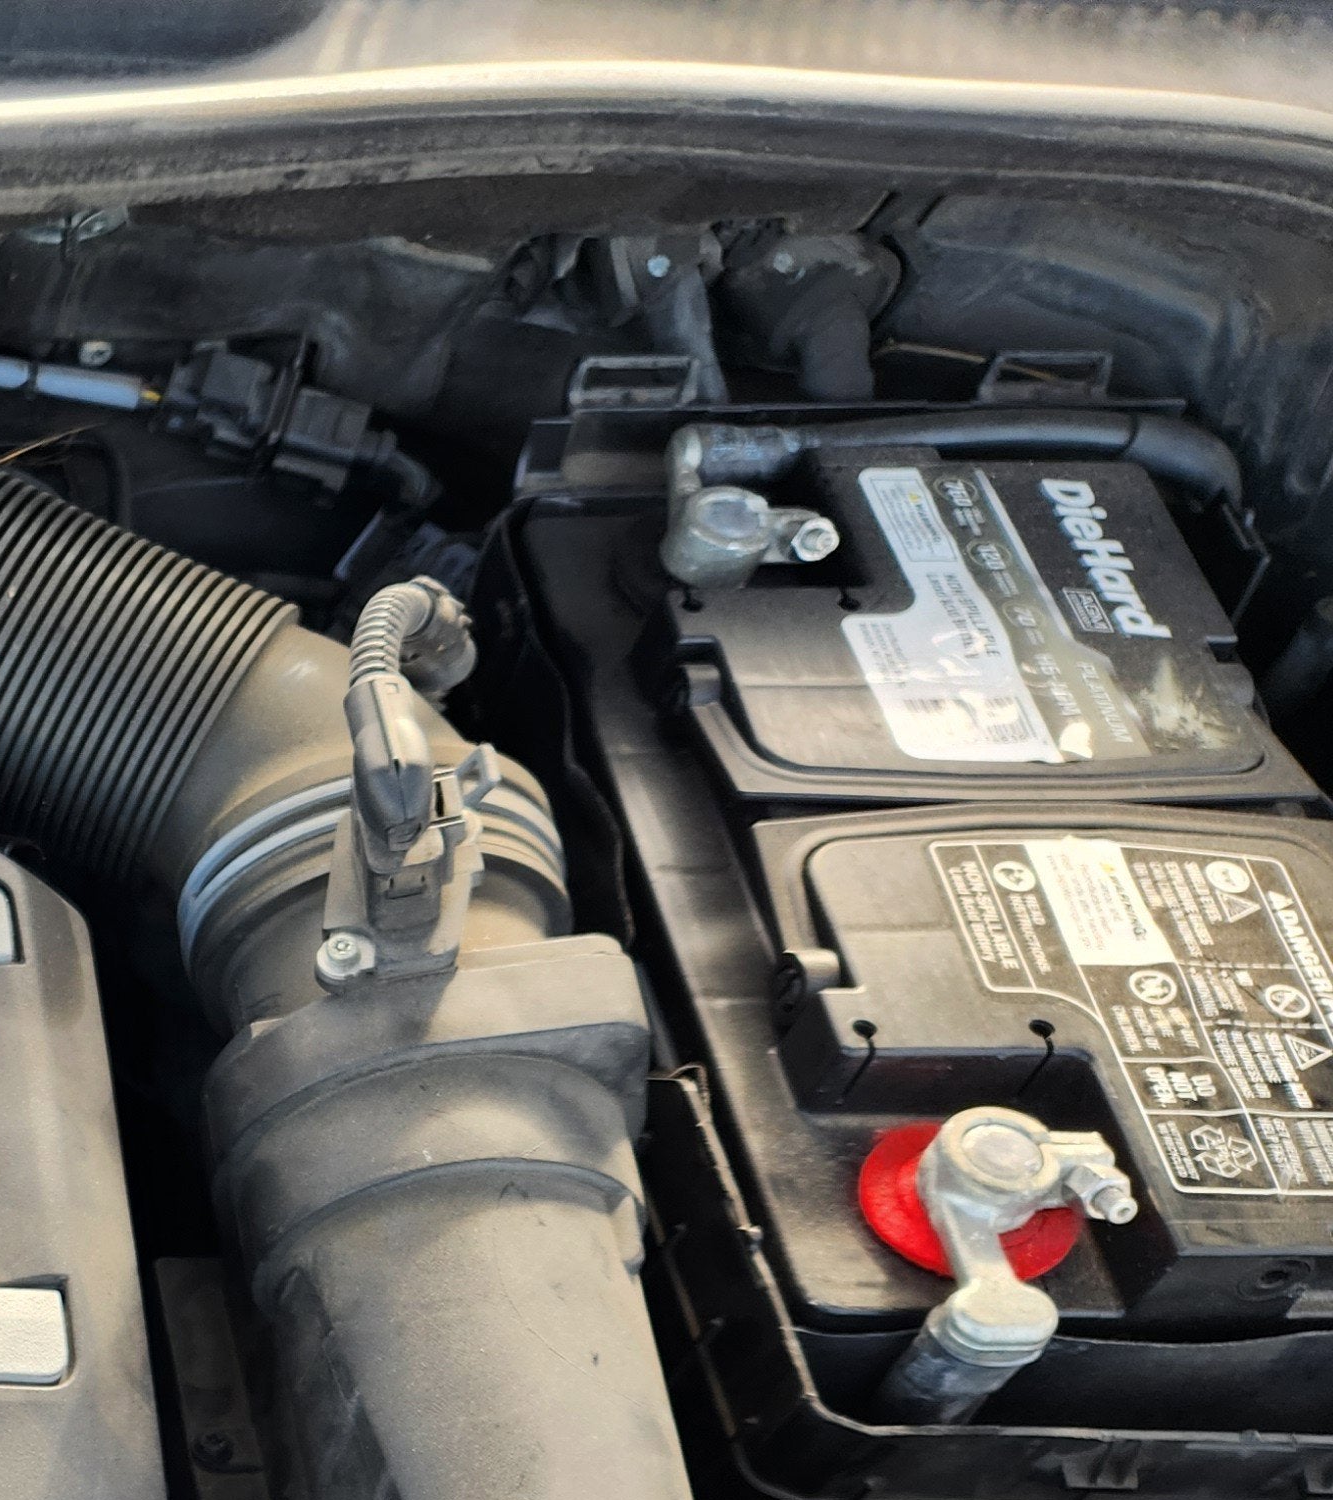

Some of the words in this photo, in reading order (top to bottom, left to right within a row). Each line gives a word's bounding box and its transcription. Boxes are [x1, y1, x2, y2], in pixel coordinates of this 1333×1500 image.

[1041, 478, 1173, 640] DieHard
[1077, 662, 1133, 742] PLATINUM
[959, 860, 1019, 969] NON-SPILLABLE
[1167, 1071, 1197, 1101] NOT
[1189, 1074, 1218, 1096] DO
